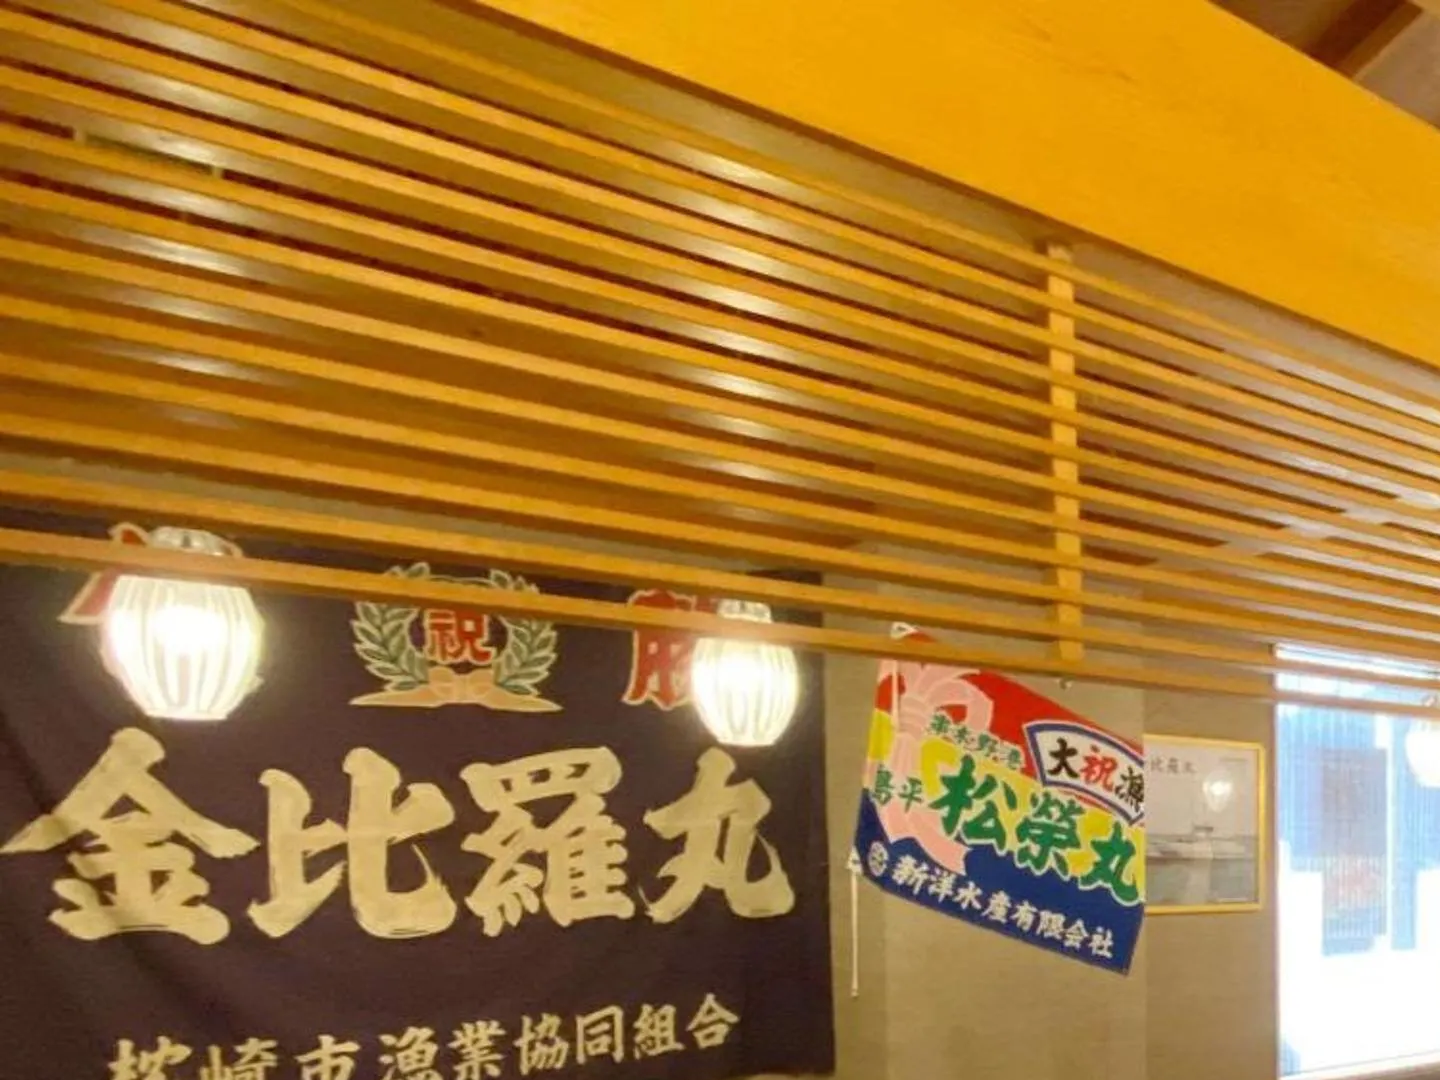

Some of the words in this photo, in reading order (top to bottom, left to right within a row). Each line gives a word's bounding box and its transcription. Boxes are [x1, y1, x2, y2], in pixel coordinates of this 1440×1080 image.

[424, 606, 494, 666] 祝
[2, 726, 797, 944] 金比羅丸
[891, 853, 1114, 959] 新洋水産有限会社
